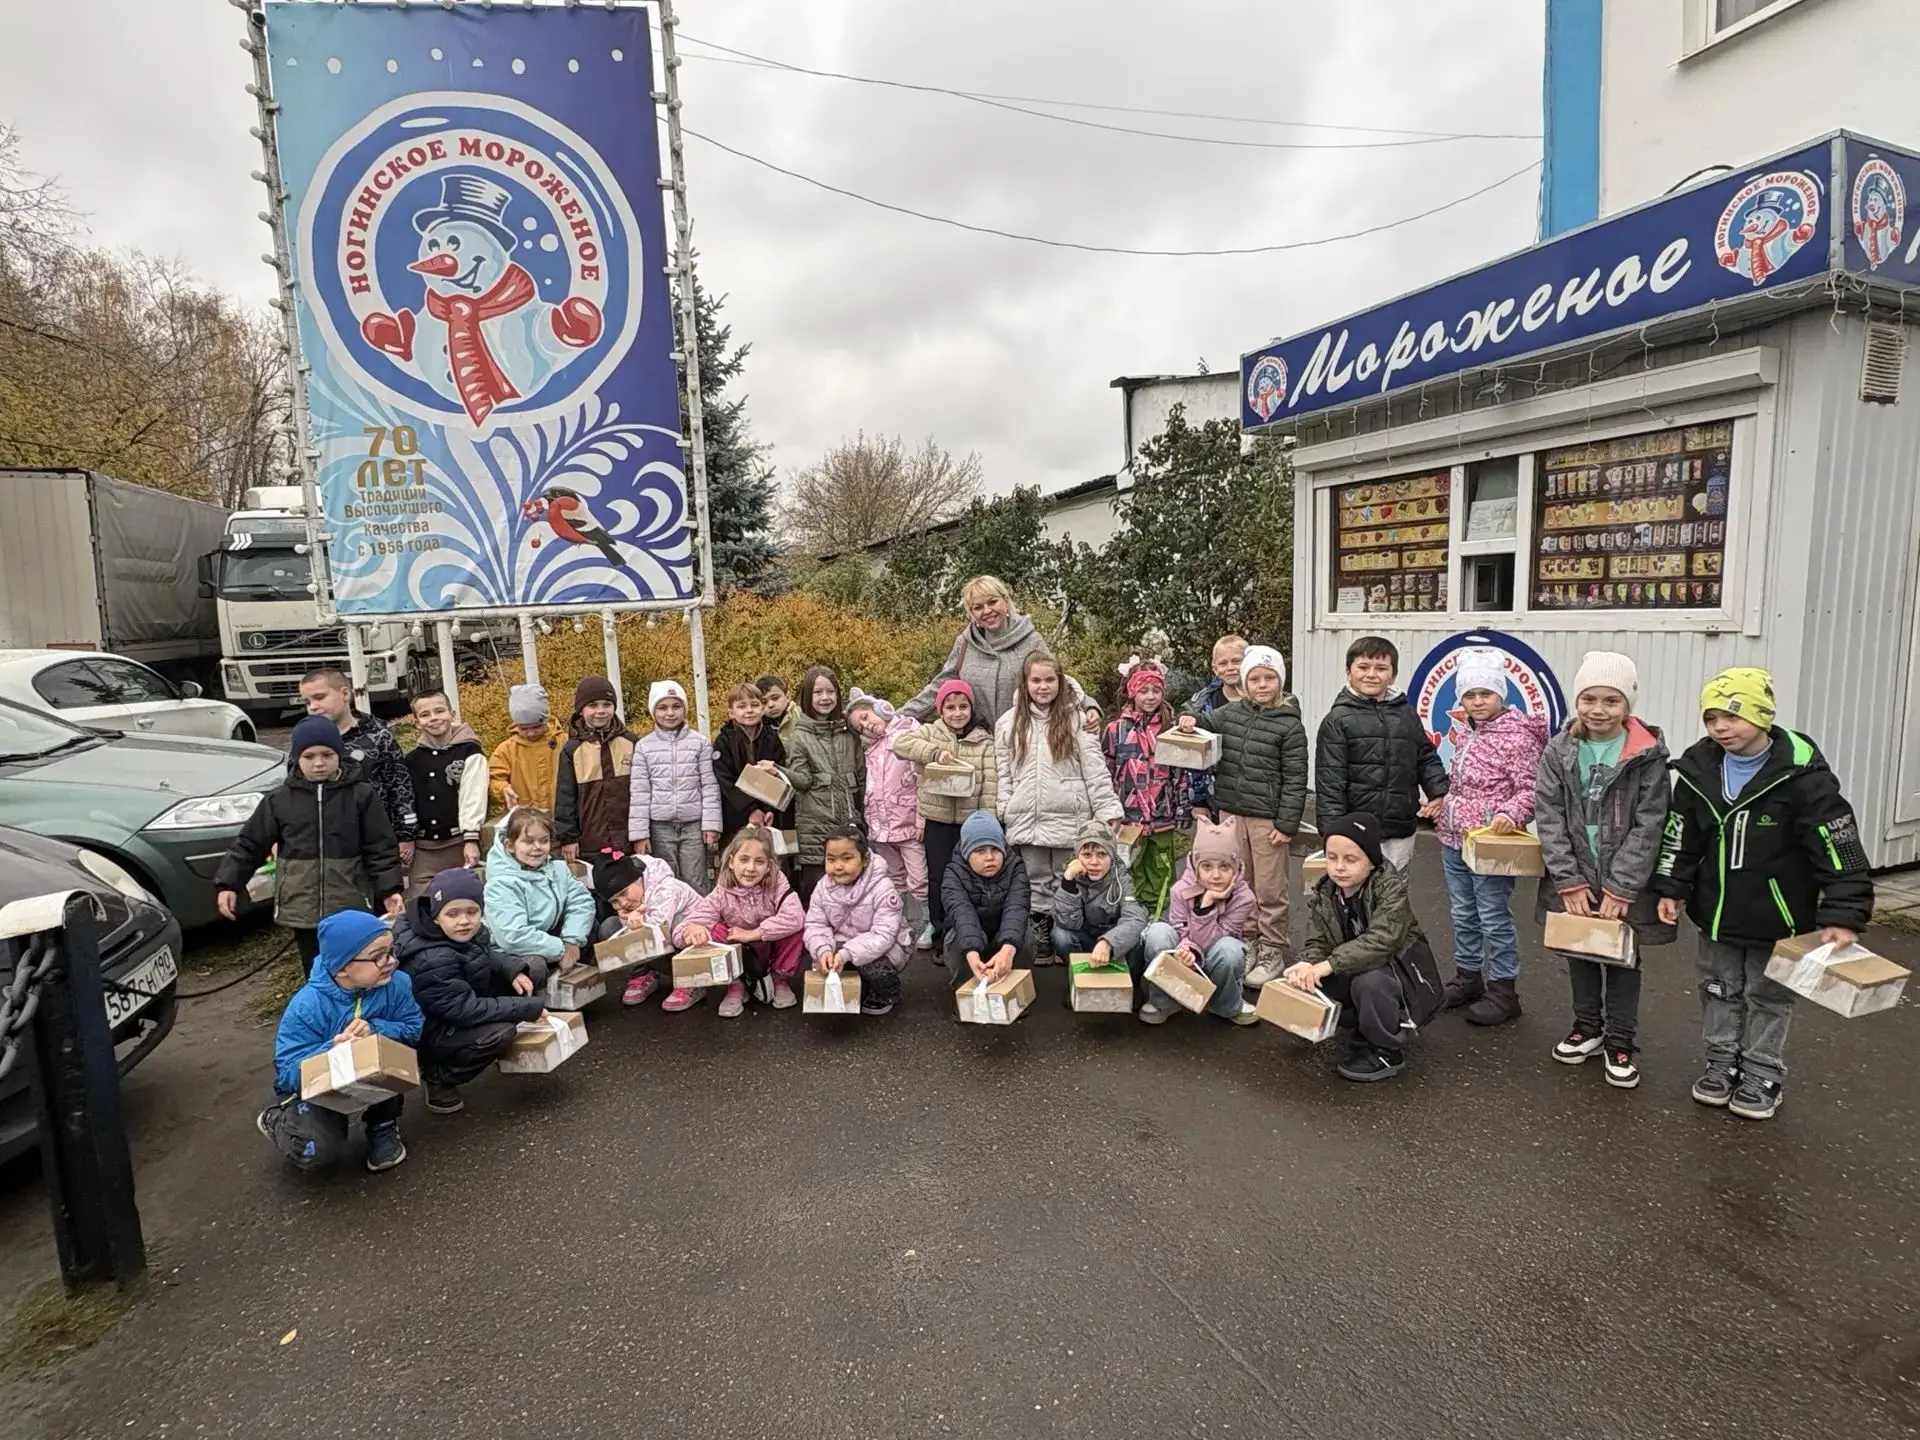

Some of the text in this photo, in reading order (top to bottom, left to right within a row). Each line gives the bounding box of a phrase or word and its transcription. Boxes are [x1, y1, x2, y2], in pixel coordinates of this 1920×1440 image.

[346, 137, 600, 296] НОГИНСКОЕ МОРОЖЕНОЕ
[1288, 237, 1693, 408] Мороженое
[363, 425, 418, 457] 70
[369, 540, 404, 556] 1956
[407, 538, 440, 553] года
[152, 951, 171, 978] 190
